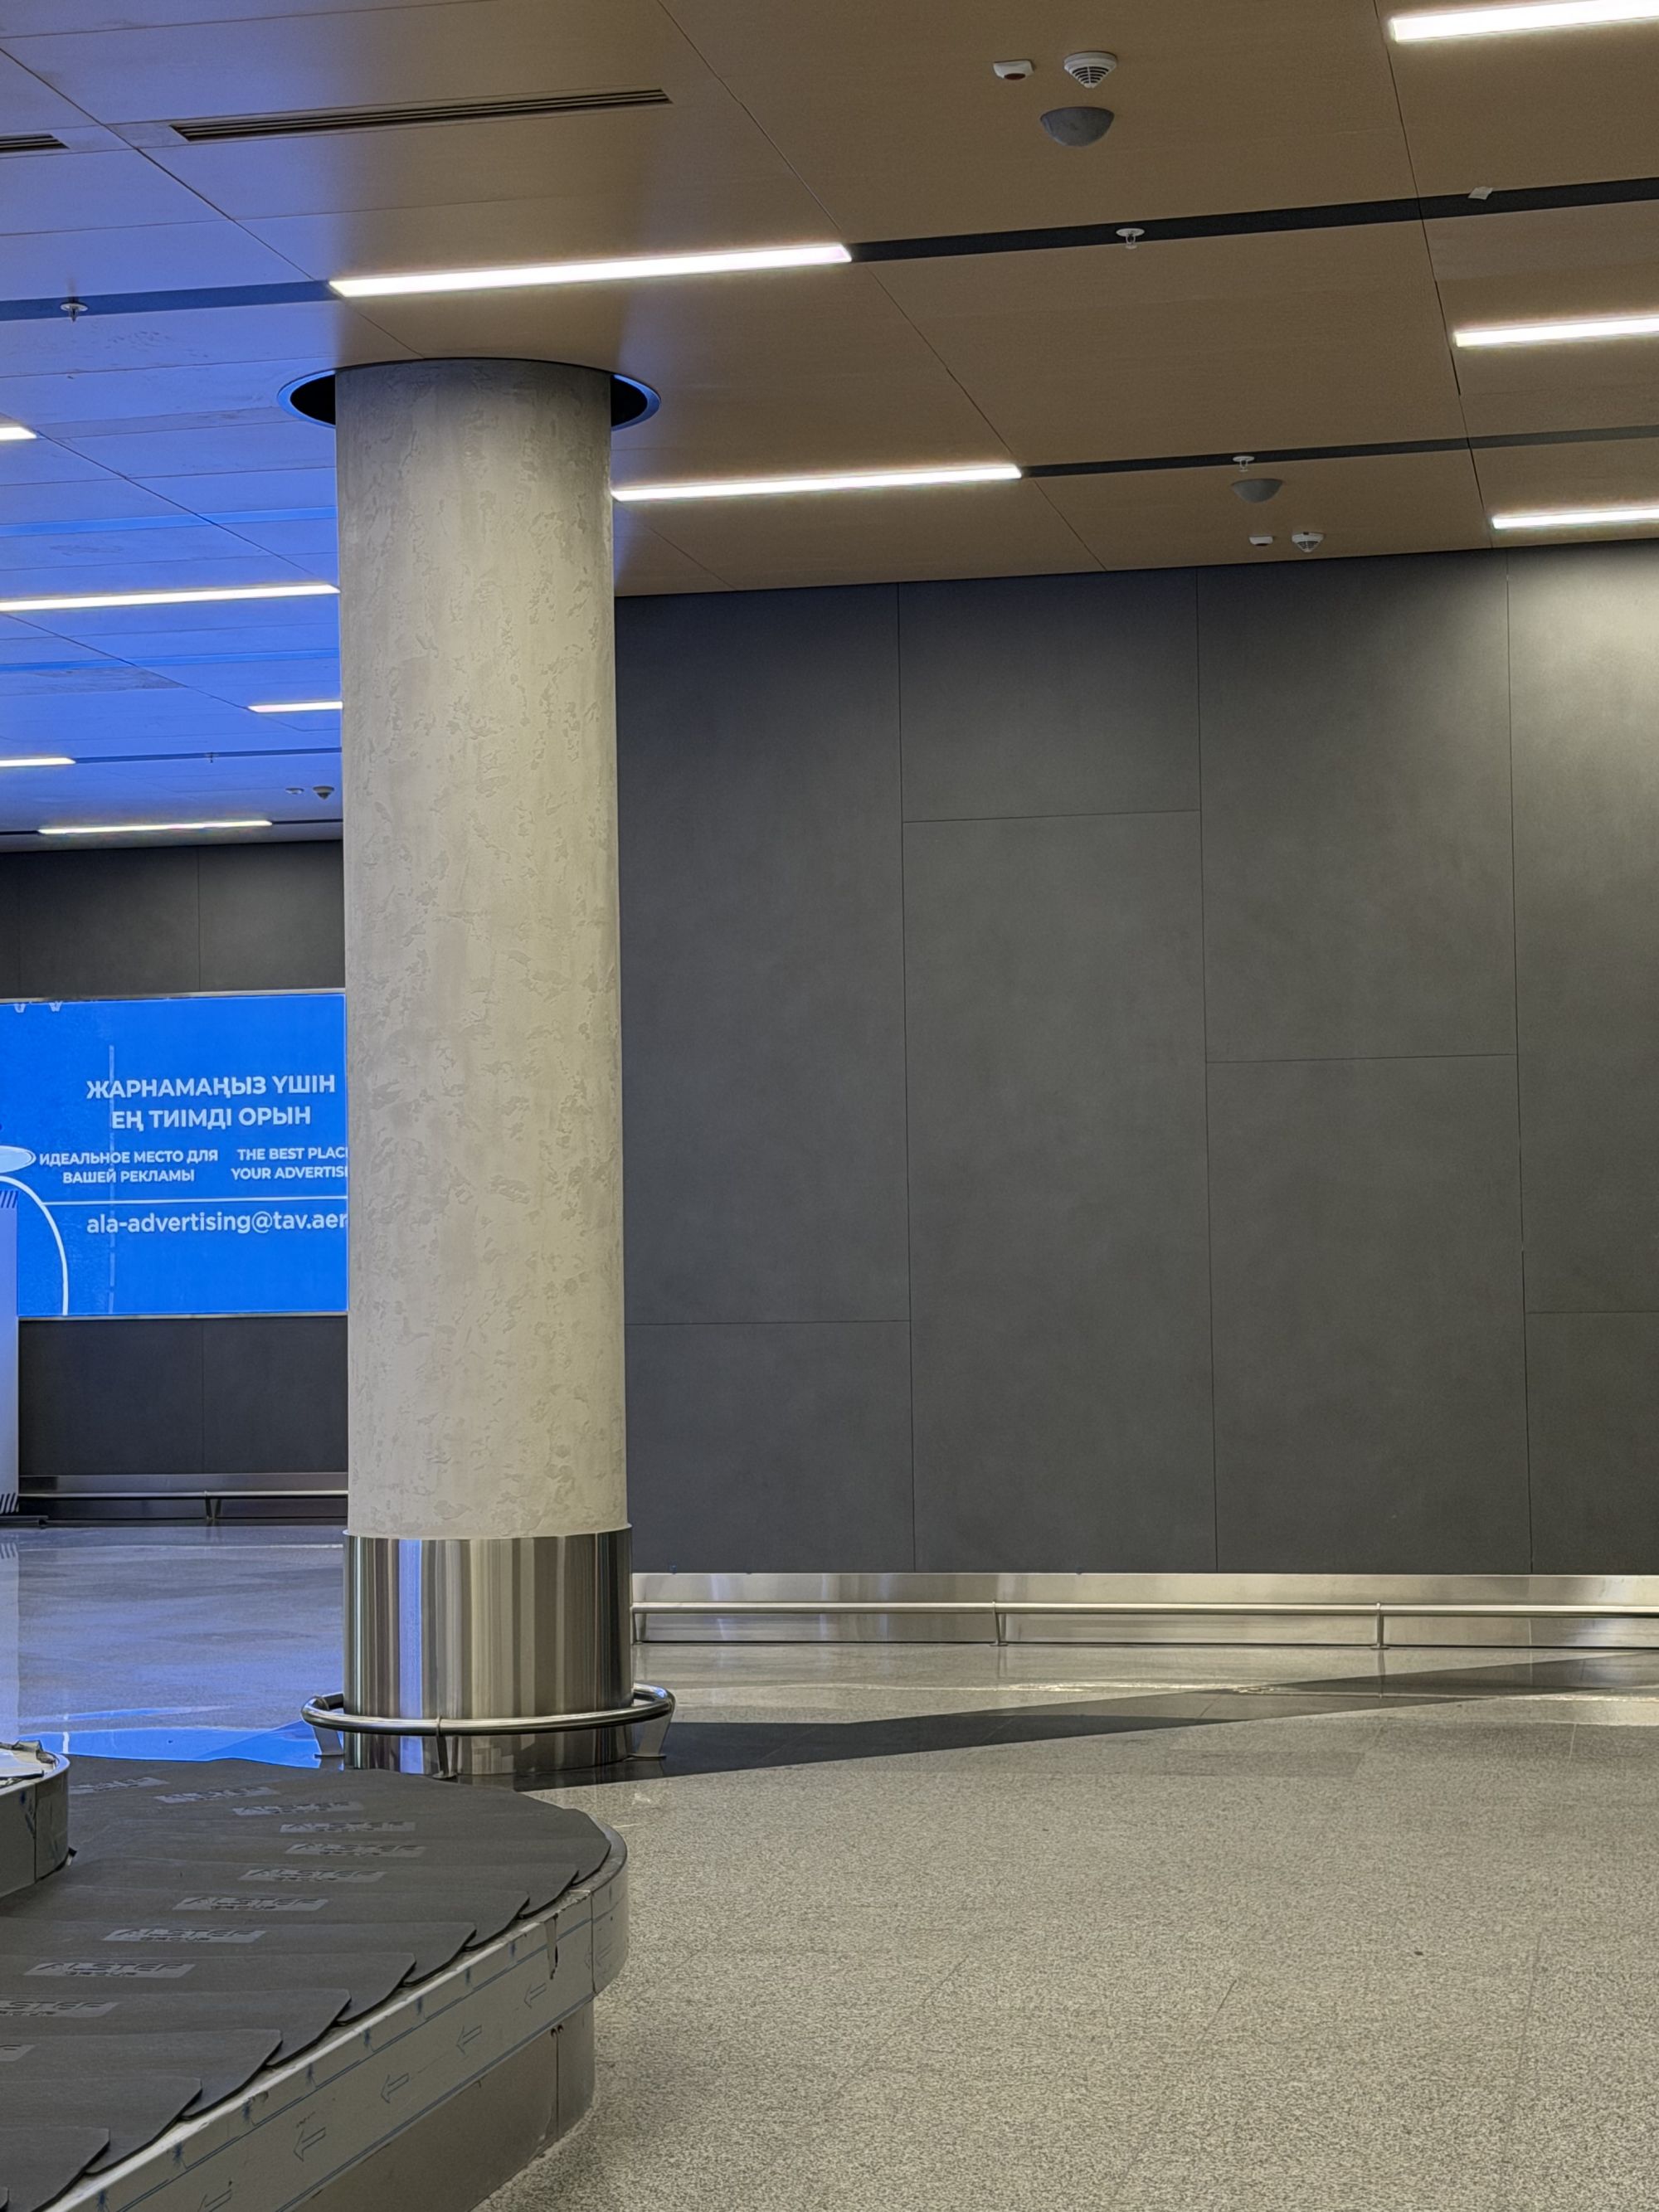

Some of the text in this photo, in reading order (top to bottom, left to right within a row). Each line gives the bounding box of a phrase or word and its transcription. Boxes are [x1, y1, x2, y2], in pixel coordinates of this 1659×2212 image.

[86, 1075, 336, 1099] ЖАРНАМАҢЫЗ ҮШІН
[112, 1106, 311, 1131] ЕҢ ТИІМДІ ОРЫН
[39, 1150, 218, 1167] ИДЕАЛЬНОЕ МЕСТО ДЛЯ
[237, 1149, 266, 1161] THE
[270, 1148, 304, 1160] BEST
[63, 1169, 195, 1184] ВАШЕЙ РЕКЛАМЫ
[231, 1168, 271, 1181] YOUR
